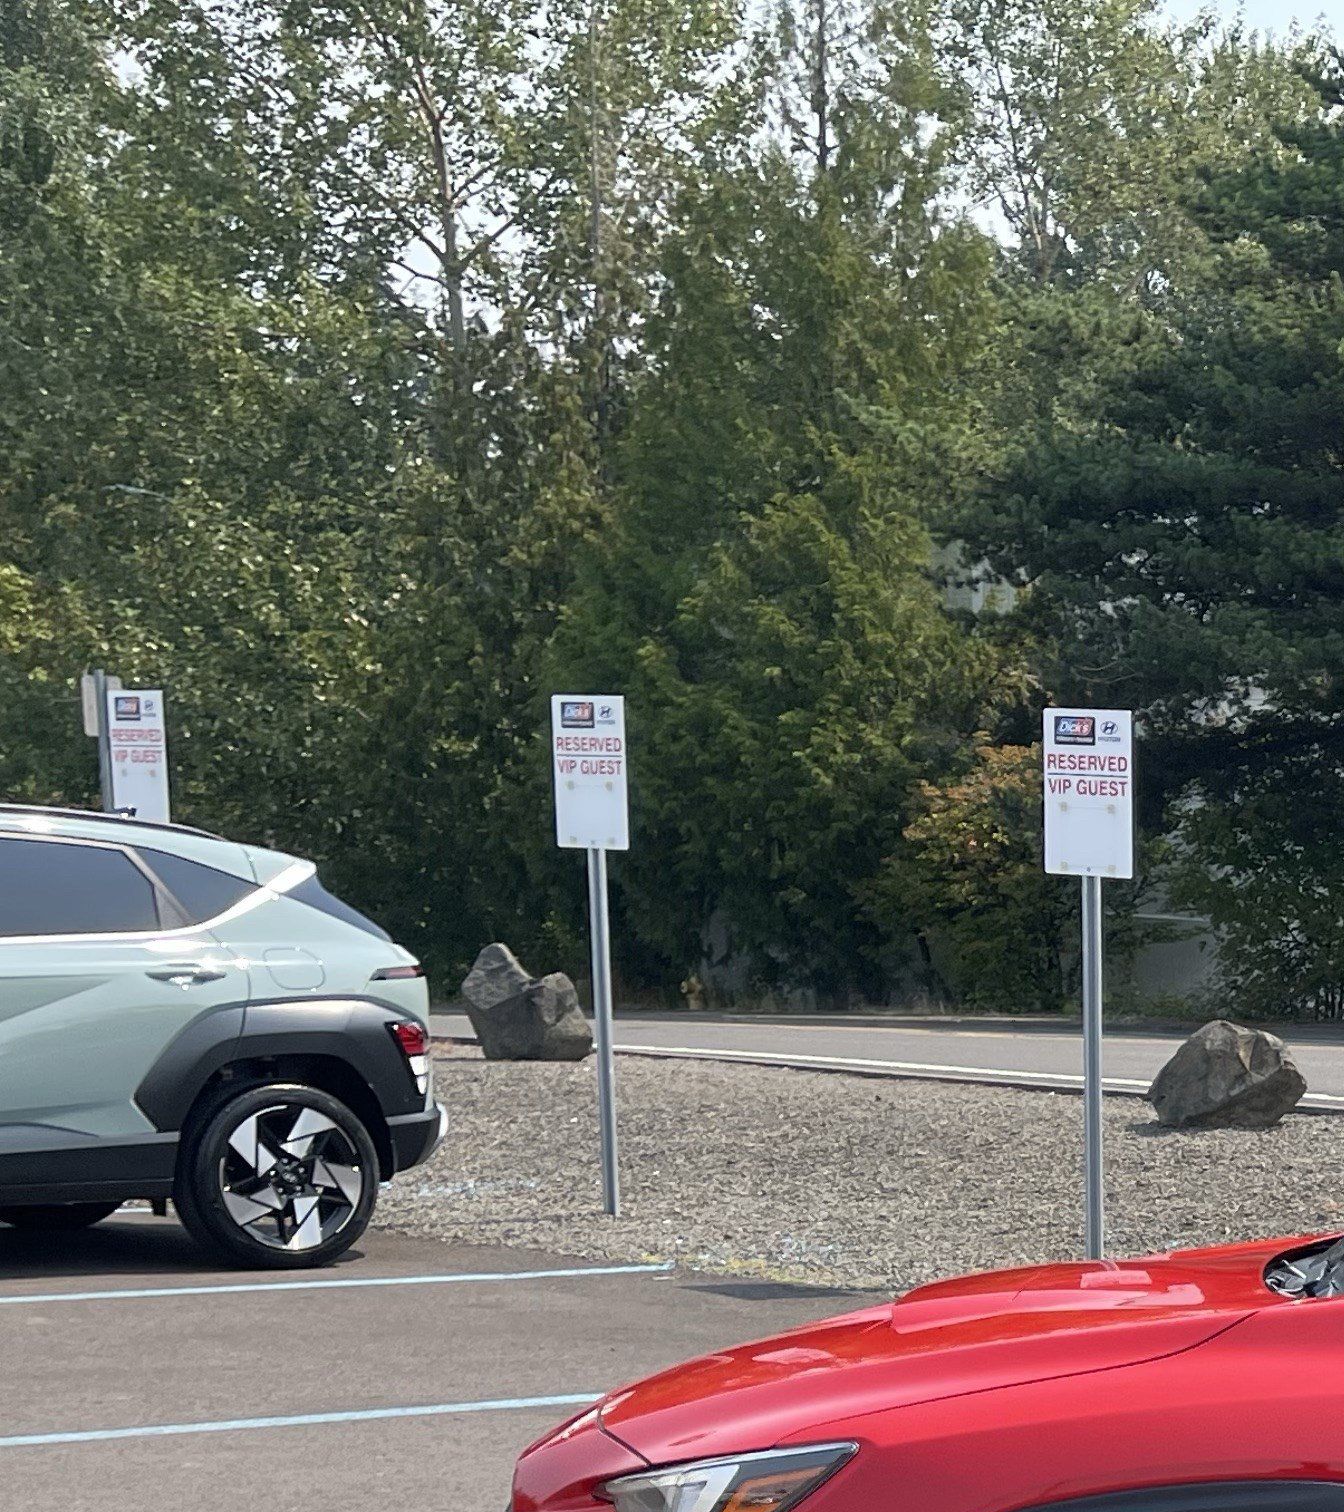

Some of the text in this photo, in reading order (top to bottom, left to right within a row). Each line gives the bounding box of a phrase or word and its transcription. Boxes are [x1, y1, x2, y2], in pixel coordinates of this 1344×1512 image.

[556, 736, 622, 752] RESERVED
[557, 759, 622, 775] VIP GUEST
[1047, 753, 1128, 772] RESERVED
[1048, 778, 1128, 797] VIP GUEST
